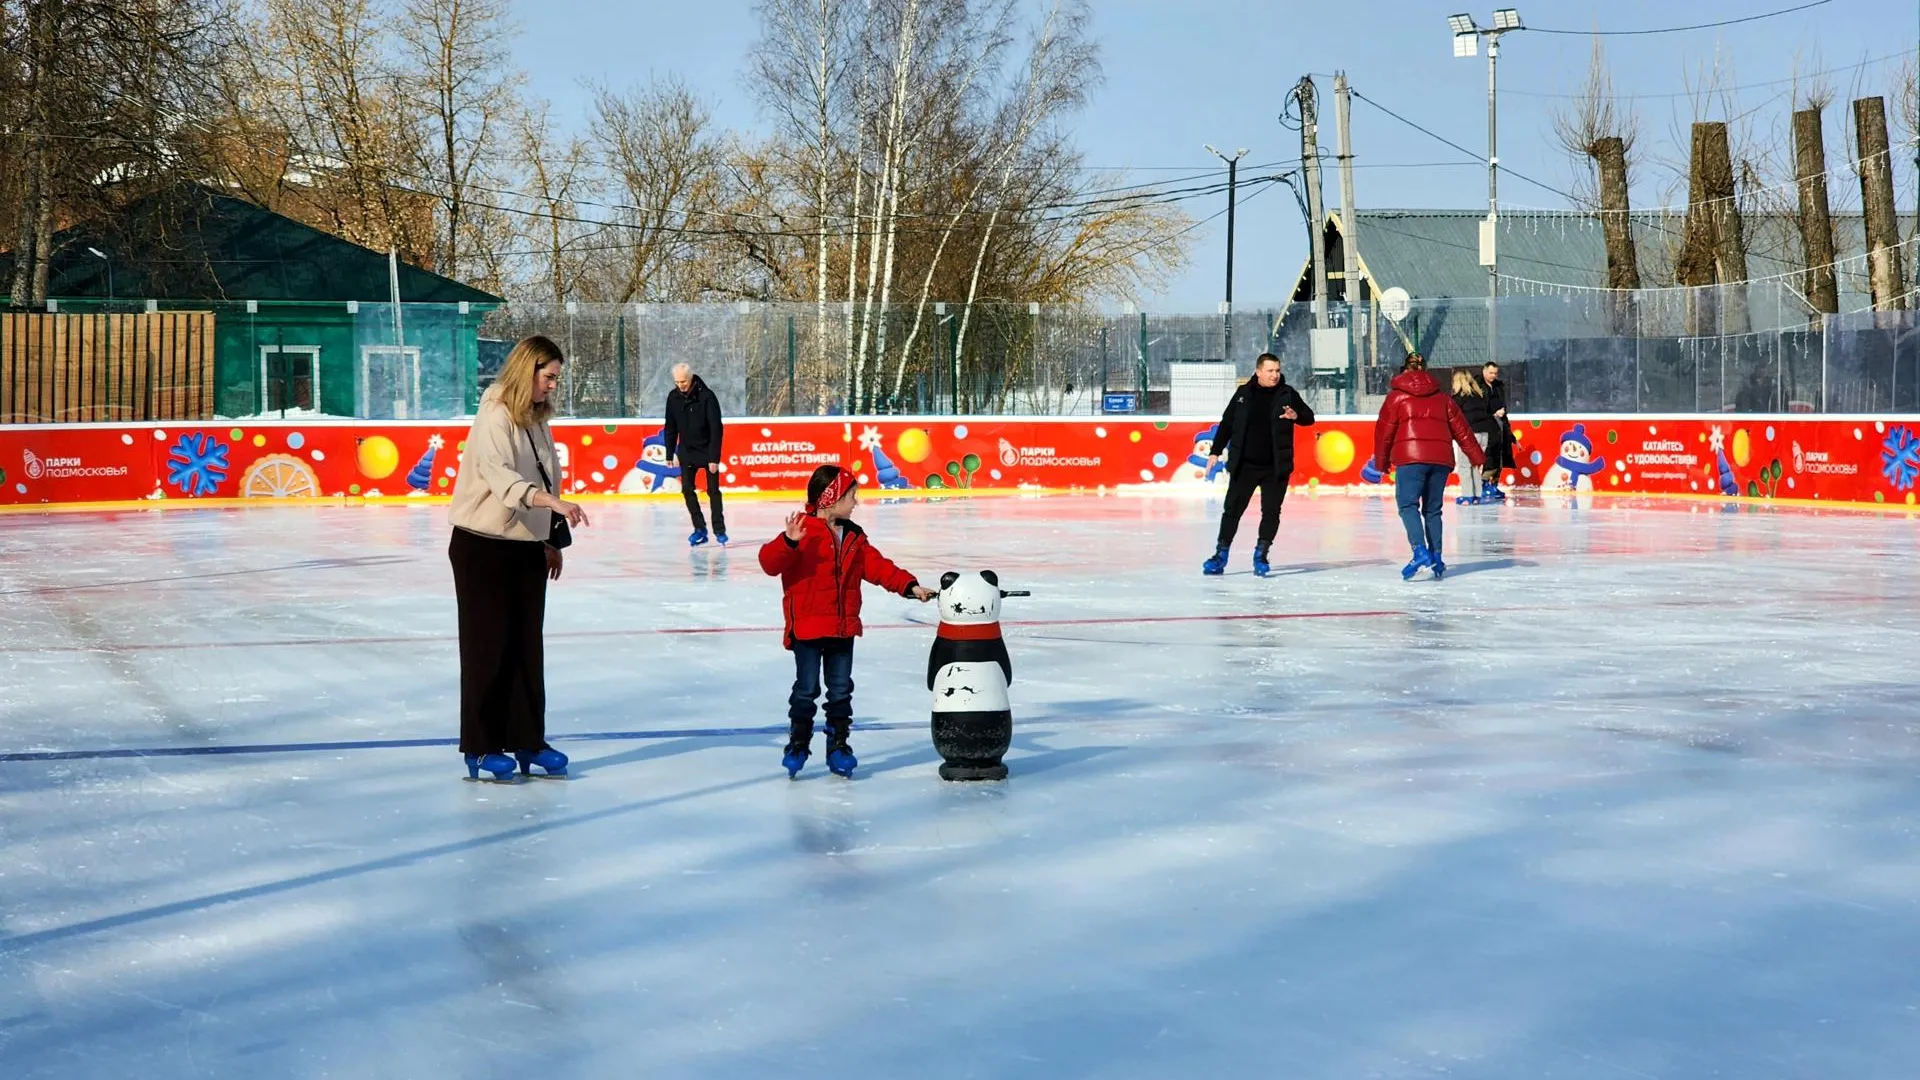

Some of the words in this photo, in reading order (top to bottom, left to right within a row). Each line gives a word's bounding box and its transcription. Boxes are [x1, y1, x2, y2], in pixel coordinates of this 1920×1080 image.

[752, 440, 815, 452] КАТАЙТЕСЬ
[1643, 439, 1684, 451] КАТАЙТЕСЬ
[1021, 448, 1055, 456] ПАРКИ
[46, 458, 81, 467] ПАРКИ
[729, 455, 738, 465] С
[740, 453, 840, 465] УДОВОЛЬСТВИЕМ!
[1021, 457, 1101, 466] ПОДМОСКОВЬЯ
[1626, 454, 1633, 464] С
[46, 466, 128, 477] ПОДМОСКОВЬЯ
